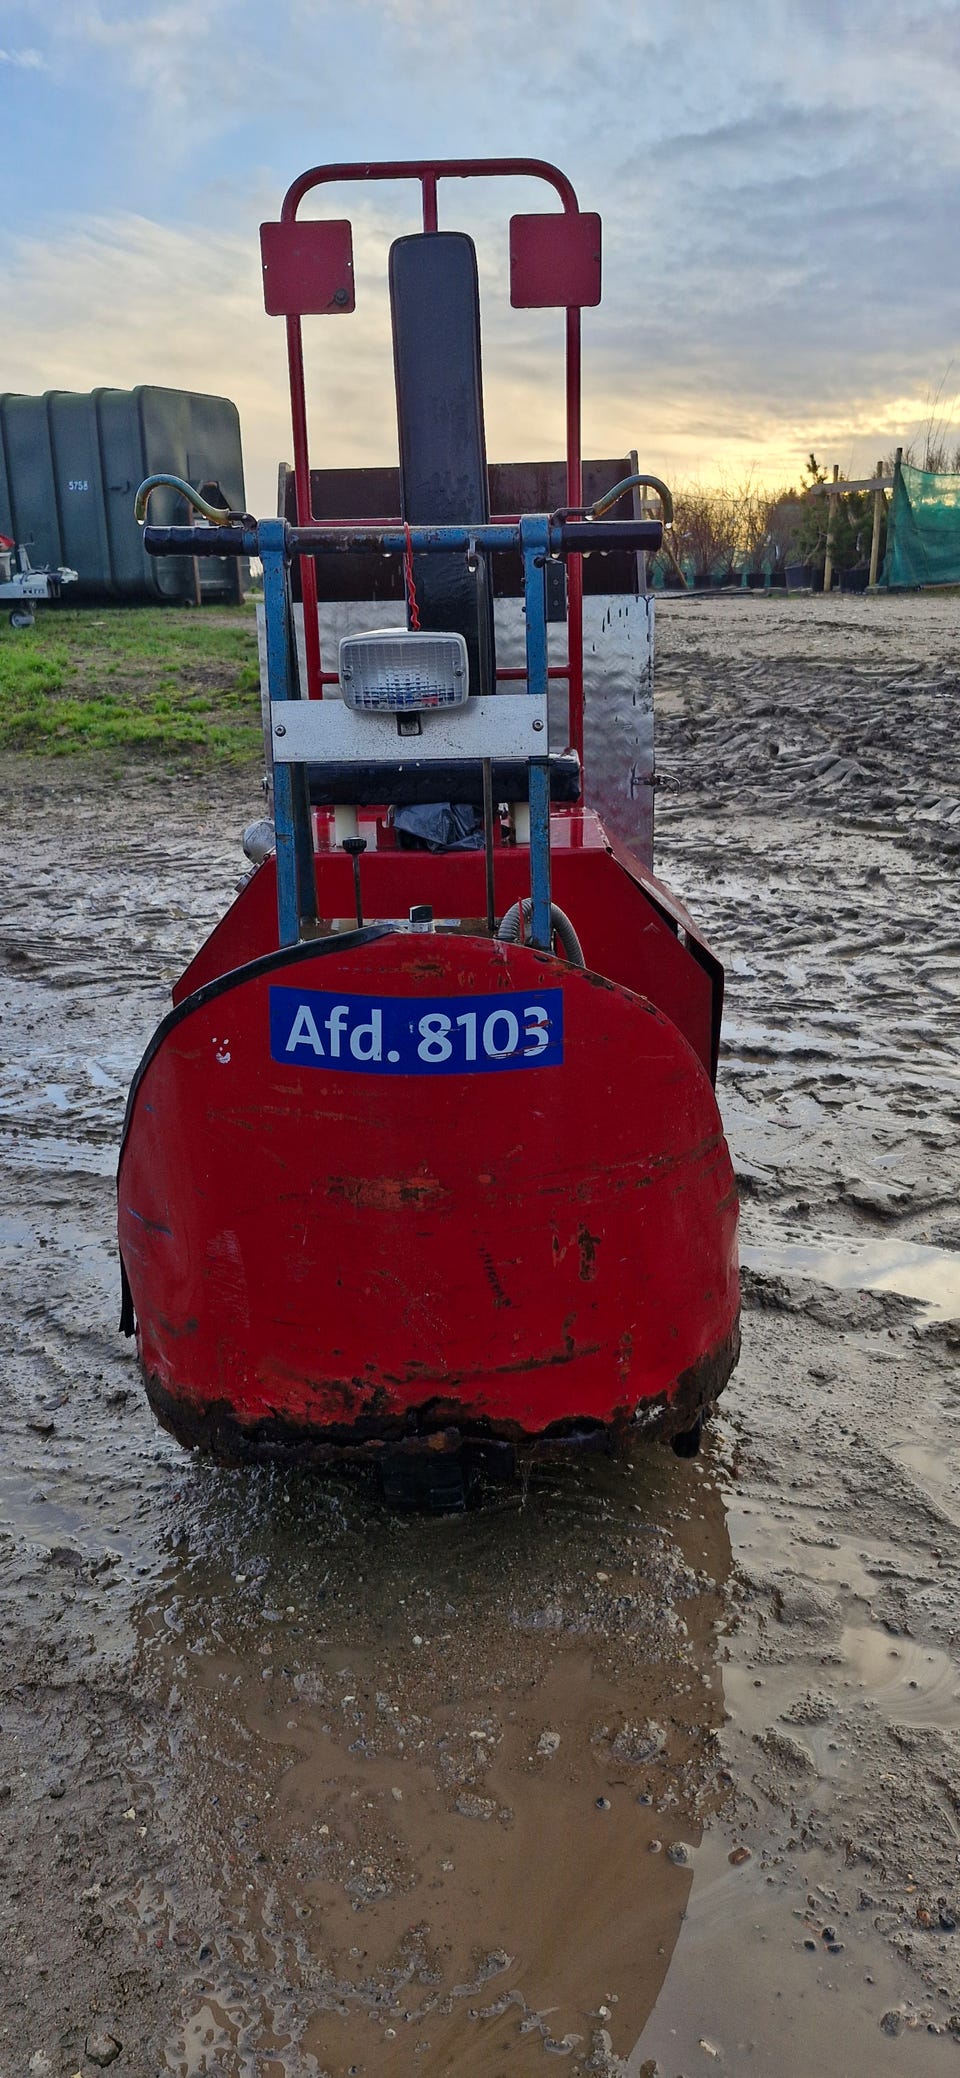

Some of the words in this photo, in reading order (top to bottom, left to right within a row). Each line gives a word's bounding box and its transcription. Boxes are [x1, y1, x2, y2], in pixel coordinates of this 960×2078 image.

[68, 481, 88, 491] 5758
[285, 1005, 400, 1063] Afd.
[417, 1006, 550, 1063] 8103
